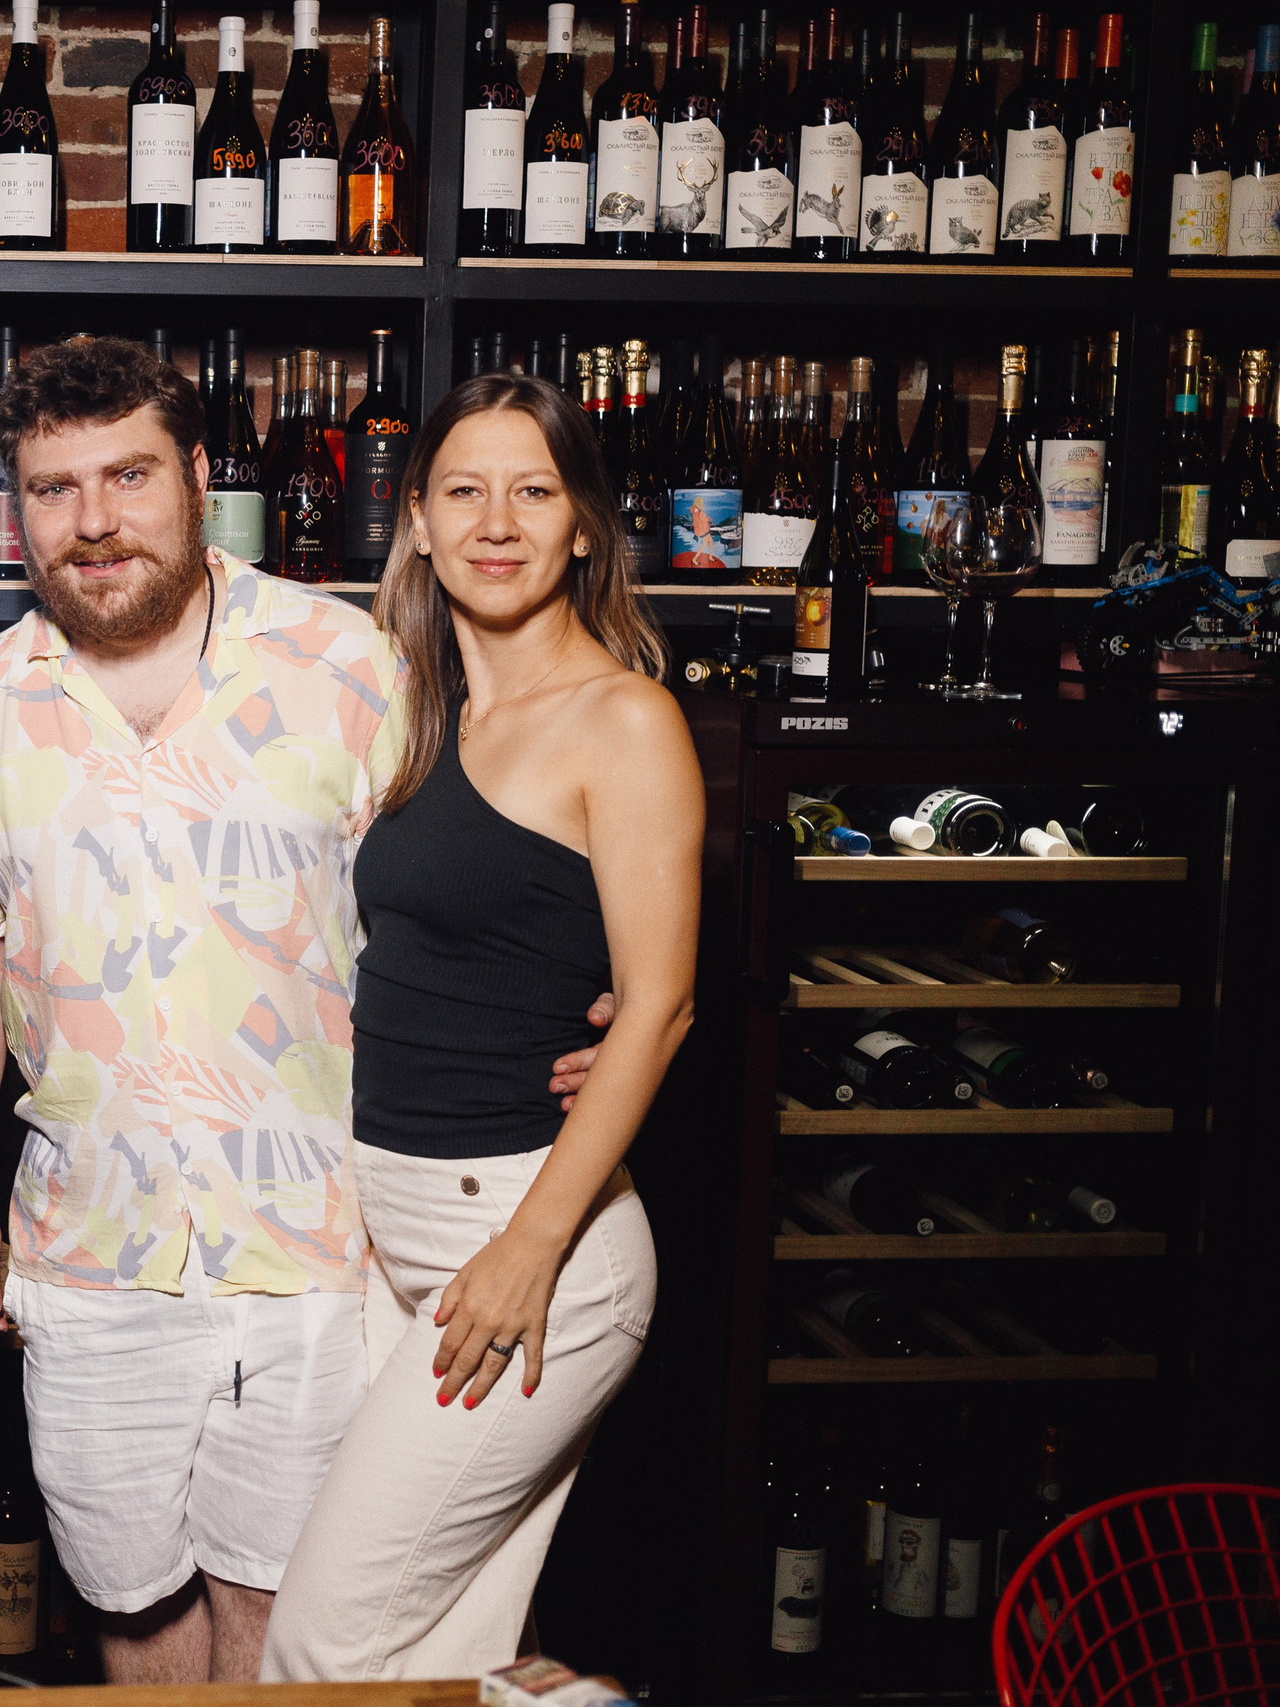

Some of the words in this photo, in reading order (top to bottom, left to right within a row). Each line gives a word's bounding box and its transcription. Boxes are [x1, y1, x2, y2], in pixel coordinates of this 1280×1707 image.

[0, 107, 50, 137] 3600
[354, 140, 406, 171] 3600
[607, 142, 646, 150] СКАЛИСТЫЙ
[213, 148, 256, 171] 5990
[739, 190, 779, 199] СКАЛИСТЫЙ
[874, 194, 914, 202] СКАЛИСТЫЙ
[208, 457, 260, 484] 2300
[284, 472, 337, 499] 1900
[371, 478, 391, 500] Q
[618, 491, 663, 512] 1800
[768, 488, 814, 510] 1500
[208, 529, 249, 538] Совиньон
[780, 717, 849, 730] POZIS
